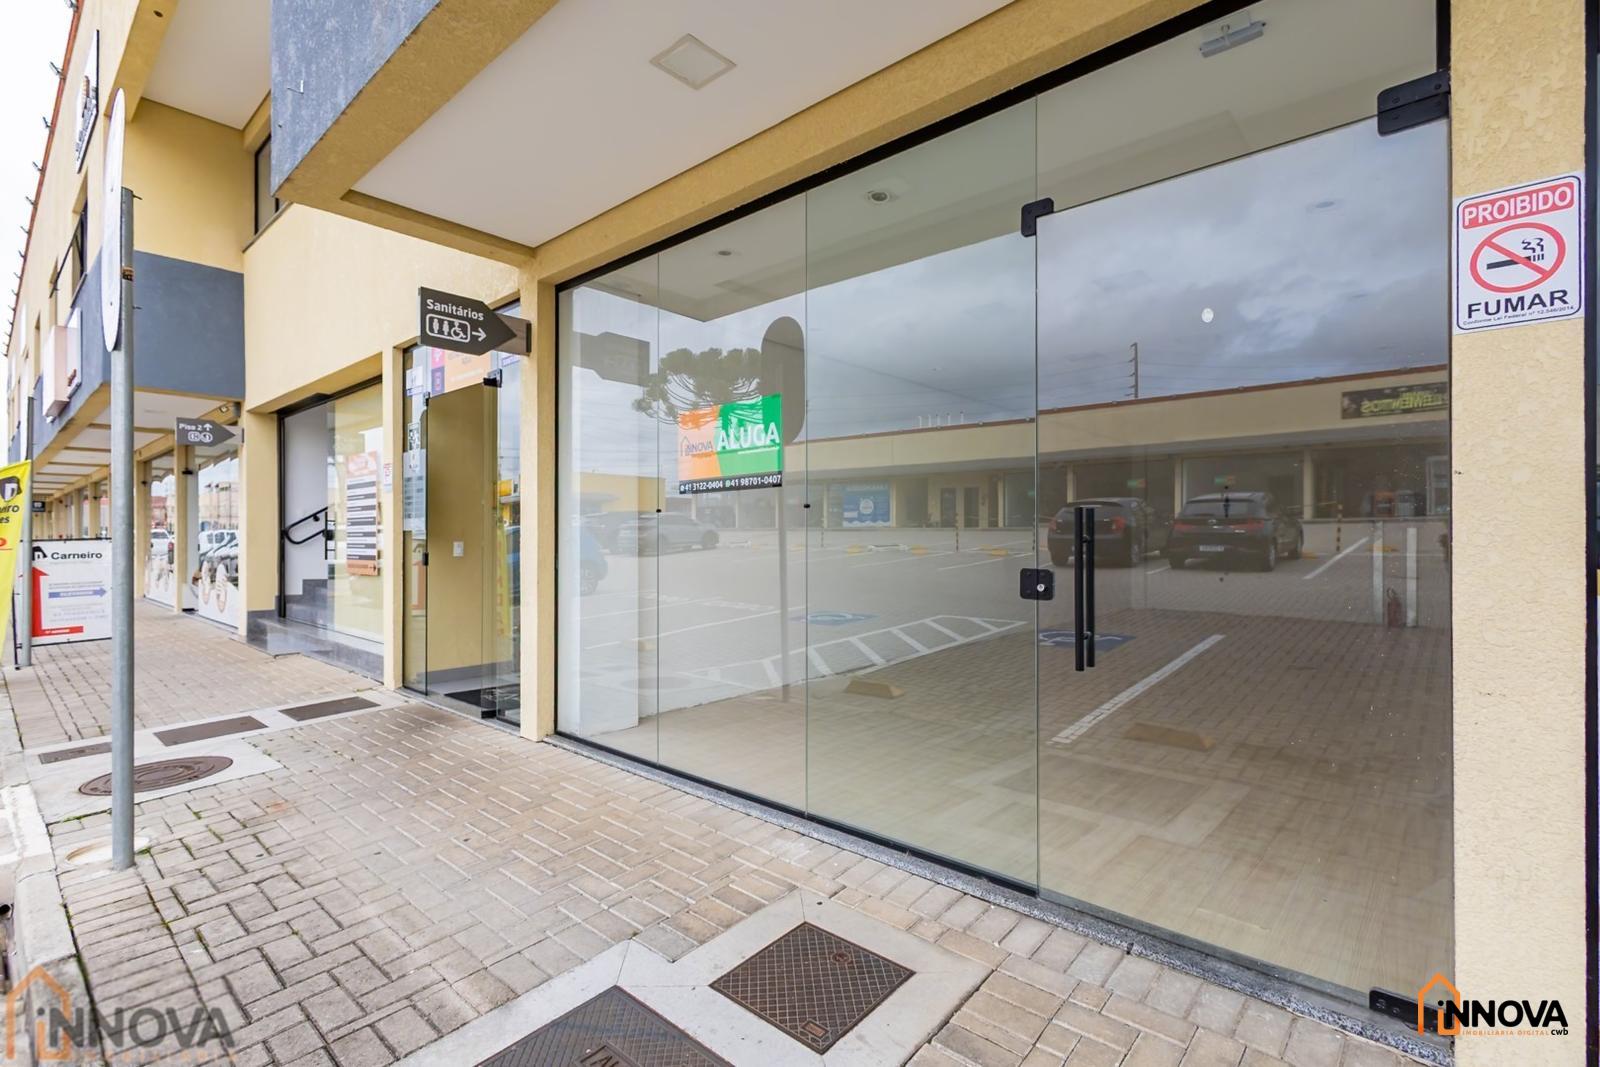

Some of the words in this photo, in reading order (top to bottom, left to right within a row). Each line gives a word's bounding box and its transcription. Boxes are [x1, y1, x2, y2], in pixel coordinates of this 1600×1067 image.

[1464, 186, 1572, 226] PROIBIDO
[426, 299, 485, 321] Sanitários
[1467, 289, 1569, 319] FUMAR
[1504, 312, 1527, 320] Federal
[717, 421, 780, 451] ALUGA
[684, 483, 692, 491] 41
[692, 480, 723, 491] 3122-0404
[730, 479, 739, 487] 41
[740, 475, 781, 486] 98701-0407
[51, 551, 103, 560] Carneiro
